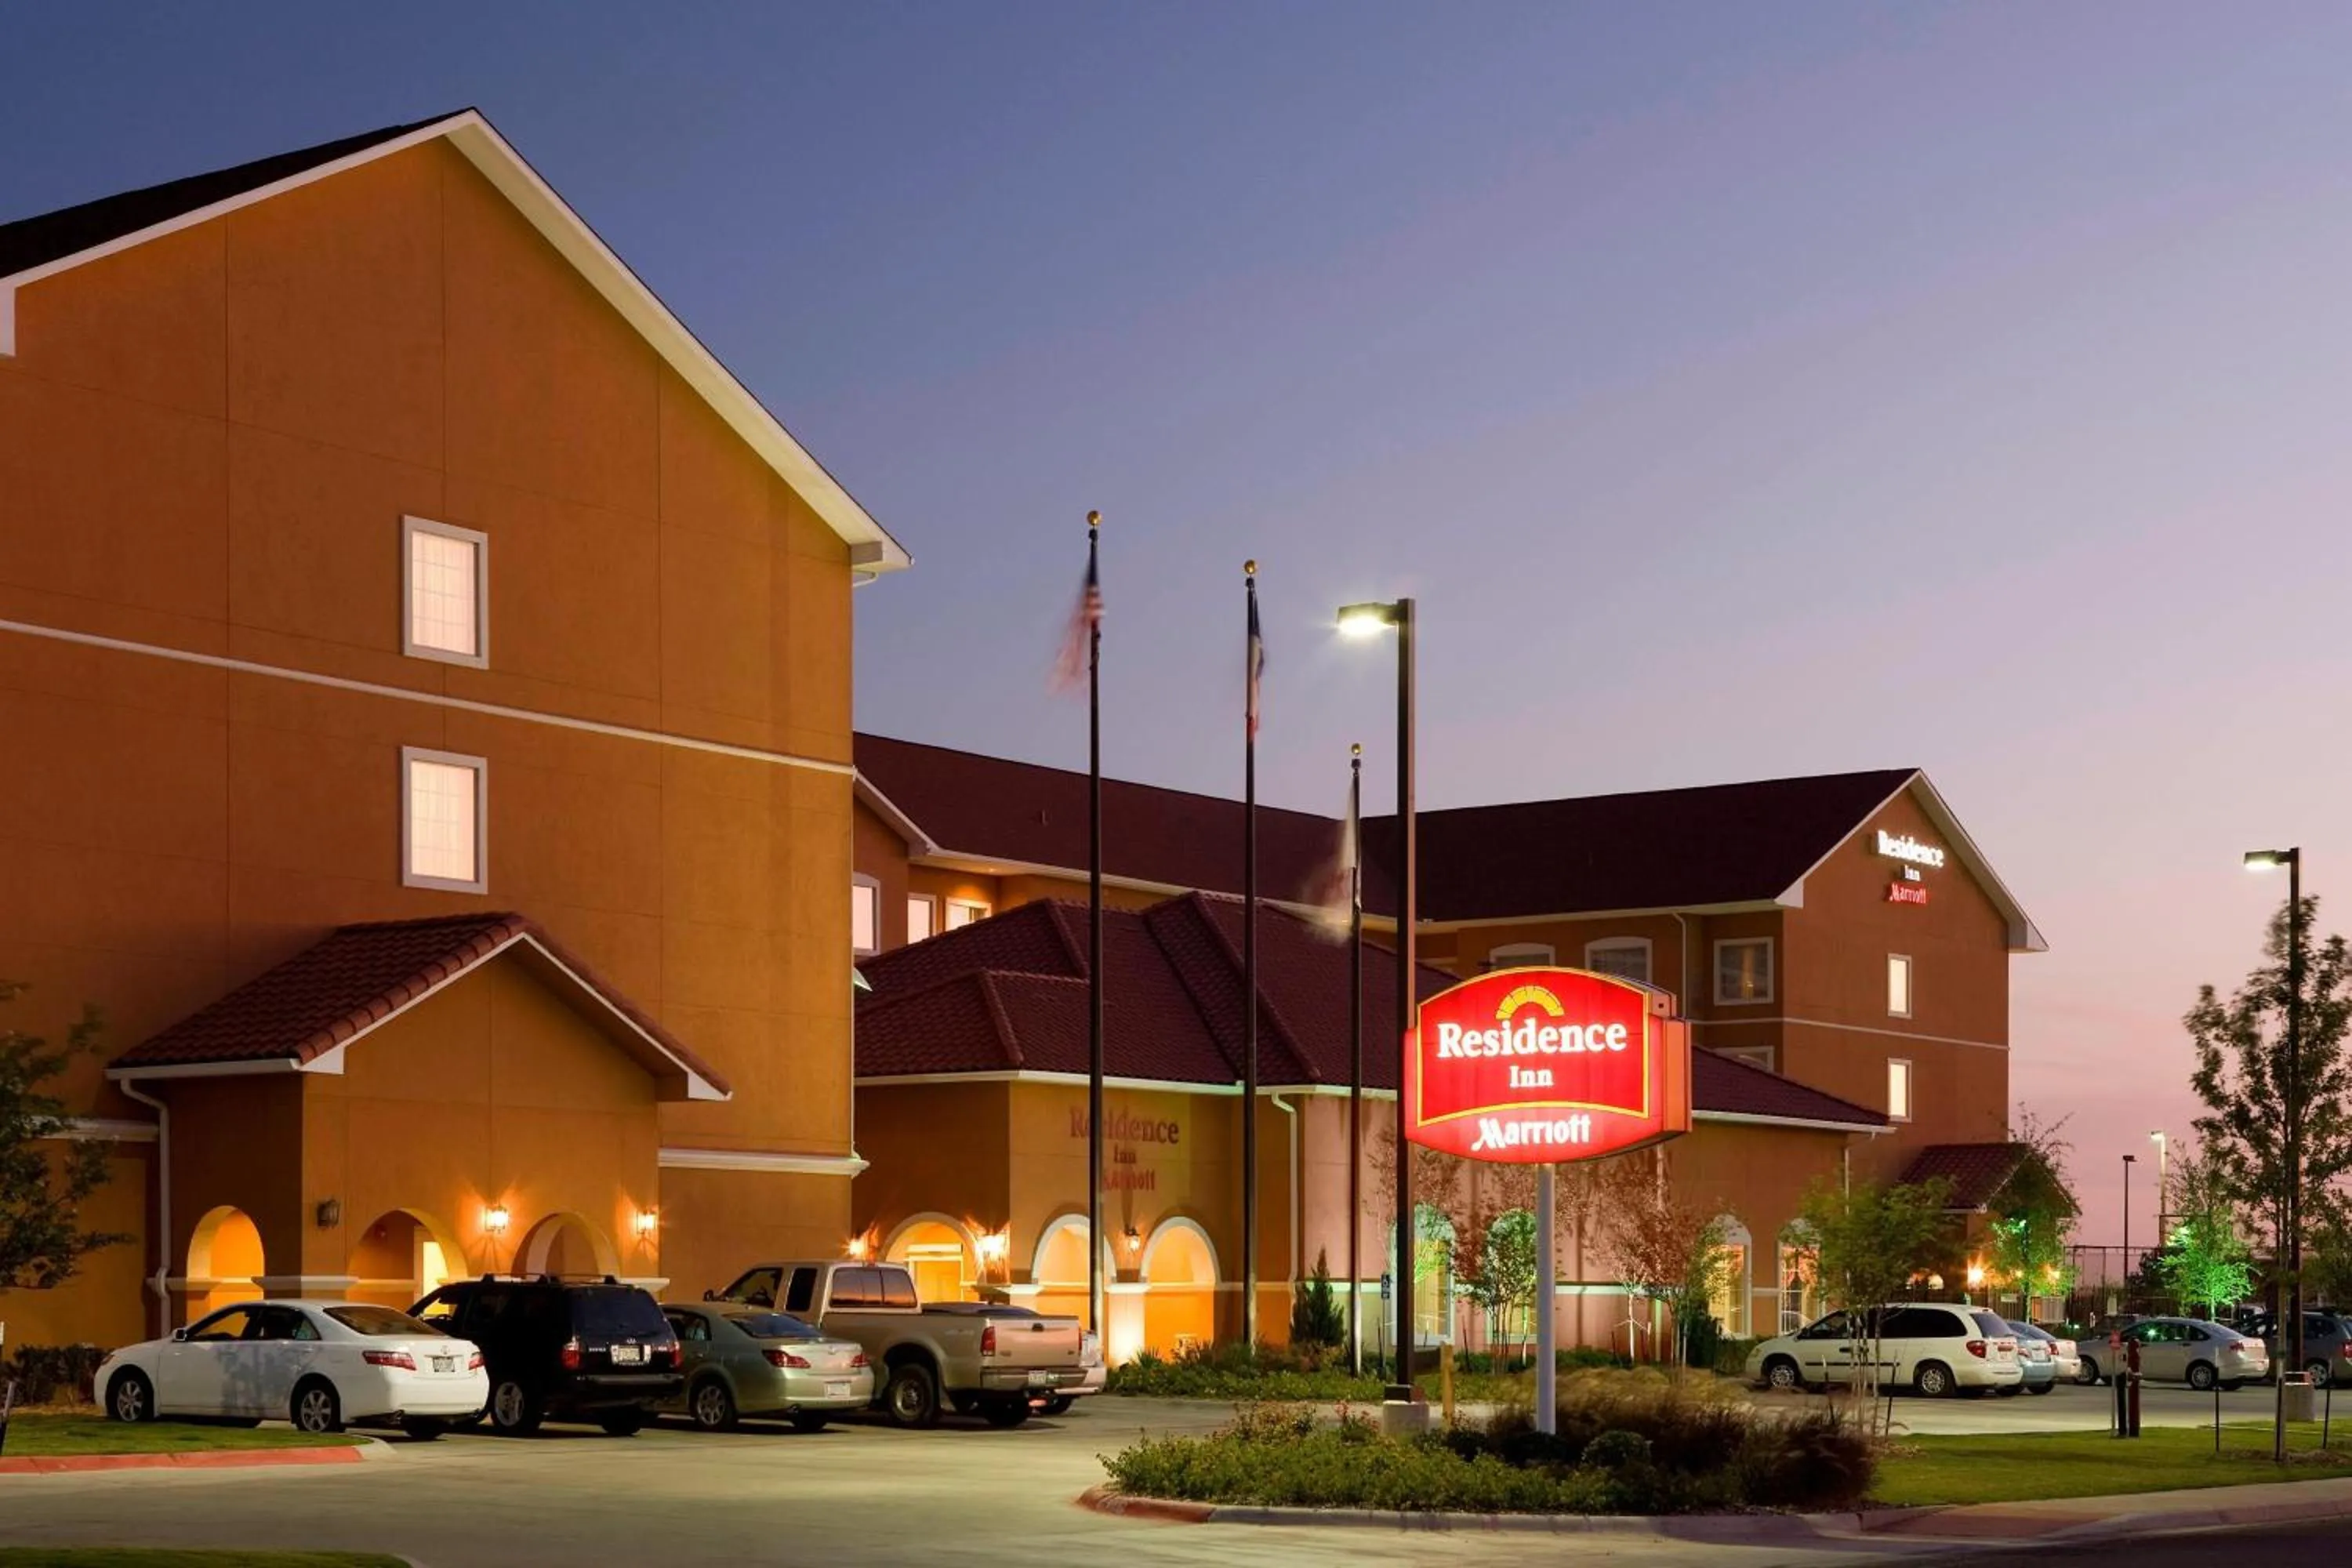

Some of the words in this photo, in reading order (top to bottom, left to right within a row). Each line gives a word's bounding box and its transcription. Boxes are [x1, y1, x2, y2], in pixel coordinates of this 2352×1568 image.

[1889, 883, 1926, 904] Marriott
[1436, 1018, 1628, 1058] Residence
[1508, 1065, 1554, 1088] Inn
[1069, 1105, 1180, 1145] Ridence
[1470, 1114, 1592, 1152] Marriott
[1113, 1144, 1137, 1164] Inn
